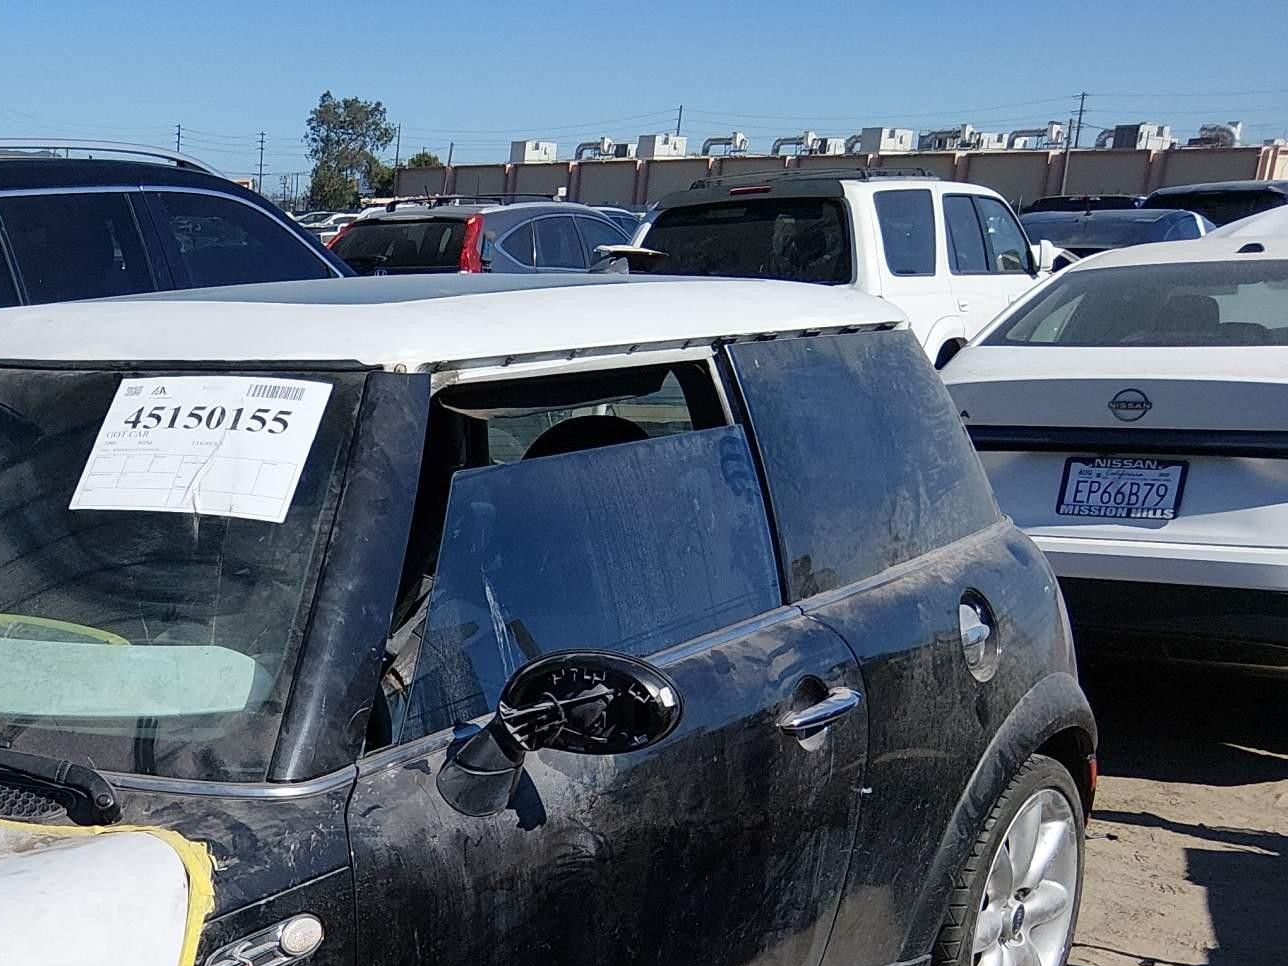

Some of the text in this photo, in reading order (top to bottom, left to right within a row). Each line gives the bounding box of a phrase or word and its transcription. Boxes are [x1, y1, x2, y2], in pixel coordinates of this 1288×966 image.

[124, 406, 293, 434] 45150155
[128, 430, 150, 438] CAR
[1095, 458, 1158, 470] NISSAN
[1073, 480, 1168, 507] EP66B79
[1059, 504, 1175, 519] MISSION HILLS
